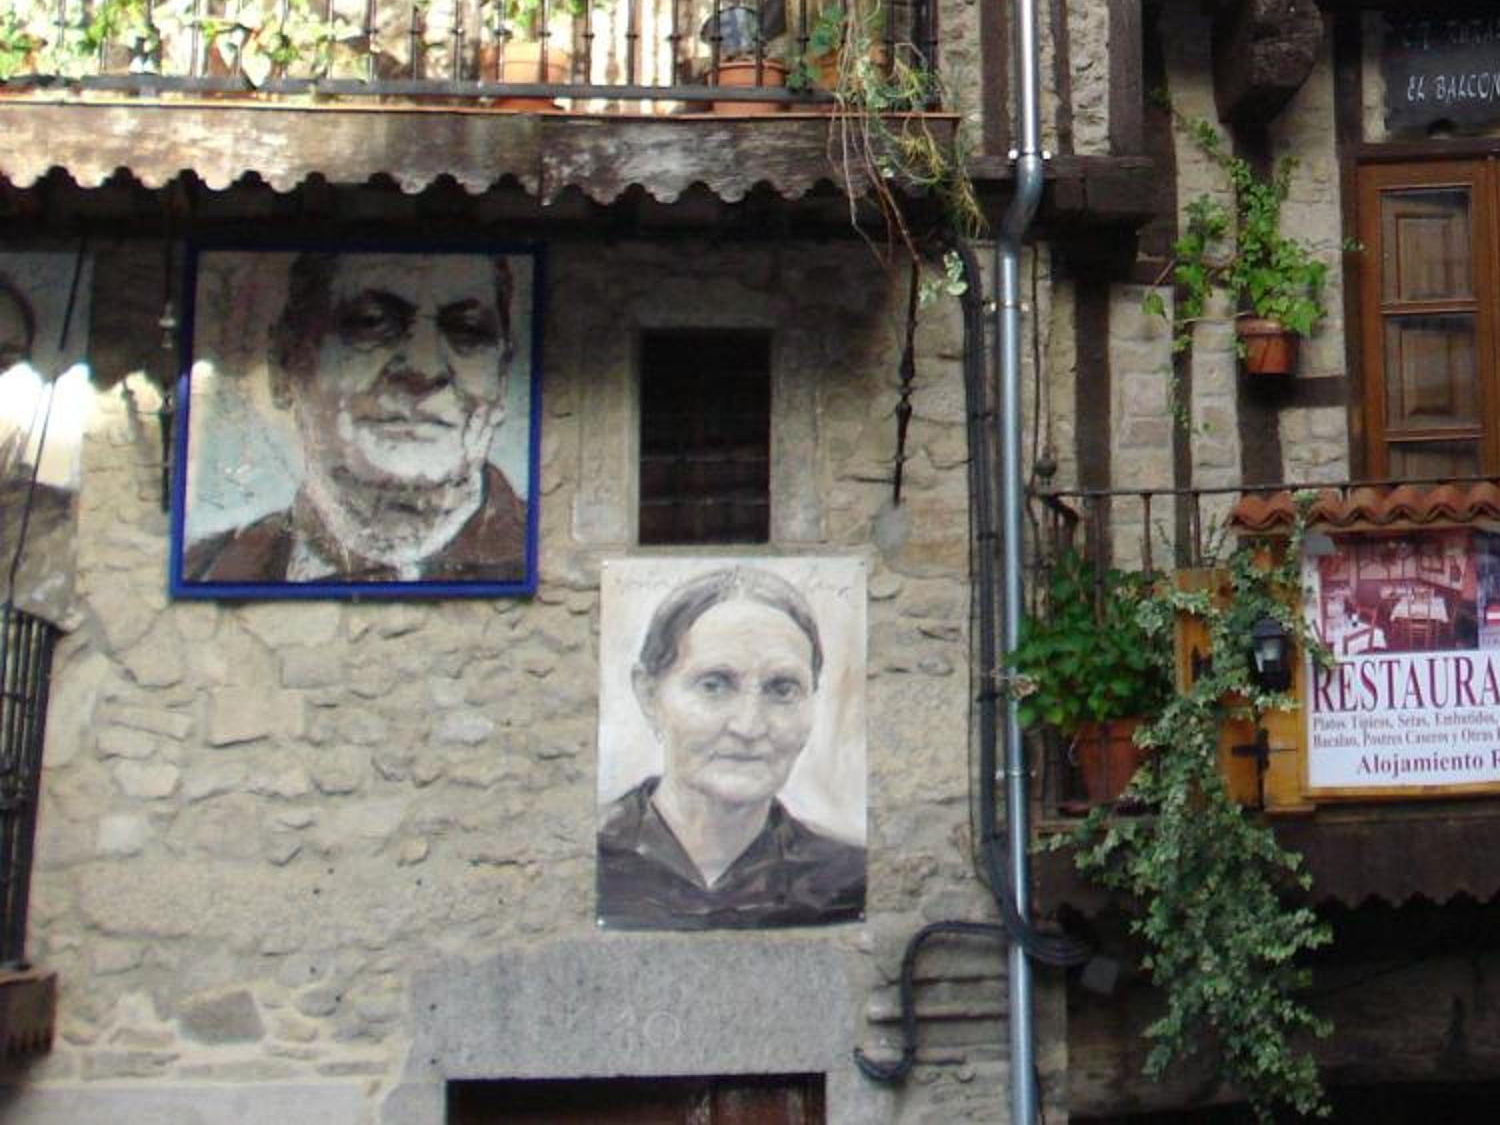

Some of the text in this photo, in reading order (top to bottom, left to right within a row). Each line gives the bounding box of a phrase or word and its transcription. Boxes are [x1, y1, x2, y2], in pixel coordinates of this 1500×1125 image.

[1407, 74, 1426, 102] EL
[1313, 716, 1346, 732] Platos
[1397, 713, 1431, 728] Setas,
[1363, 730, 1404, 747] Postres
[1405, 730, 1449, 746] Caseros
[1461, 728, 1493, 743] Otras
[1357, 750, 1484, 779] Alojamiento
